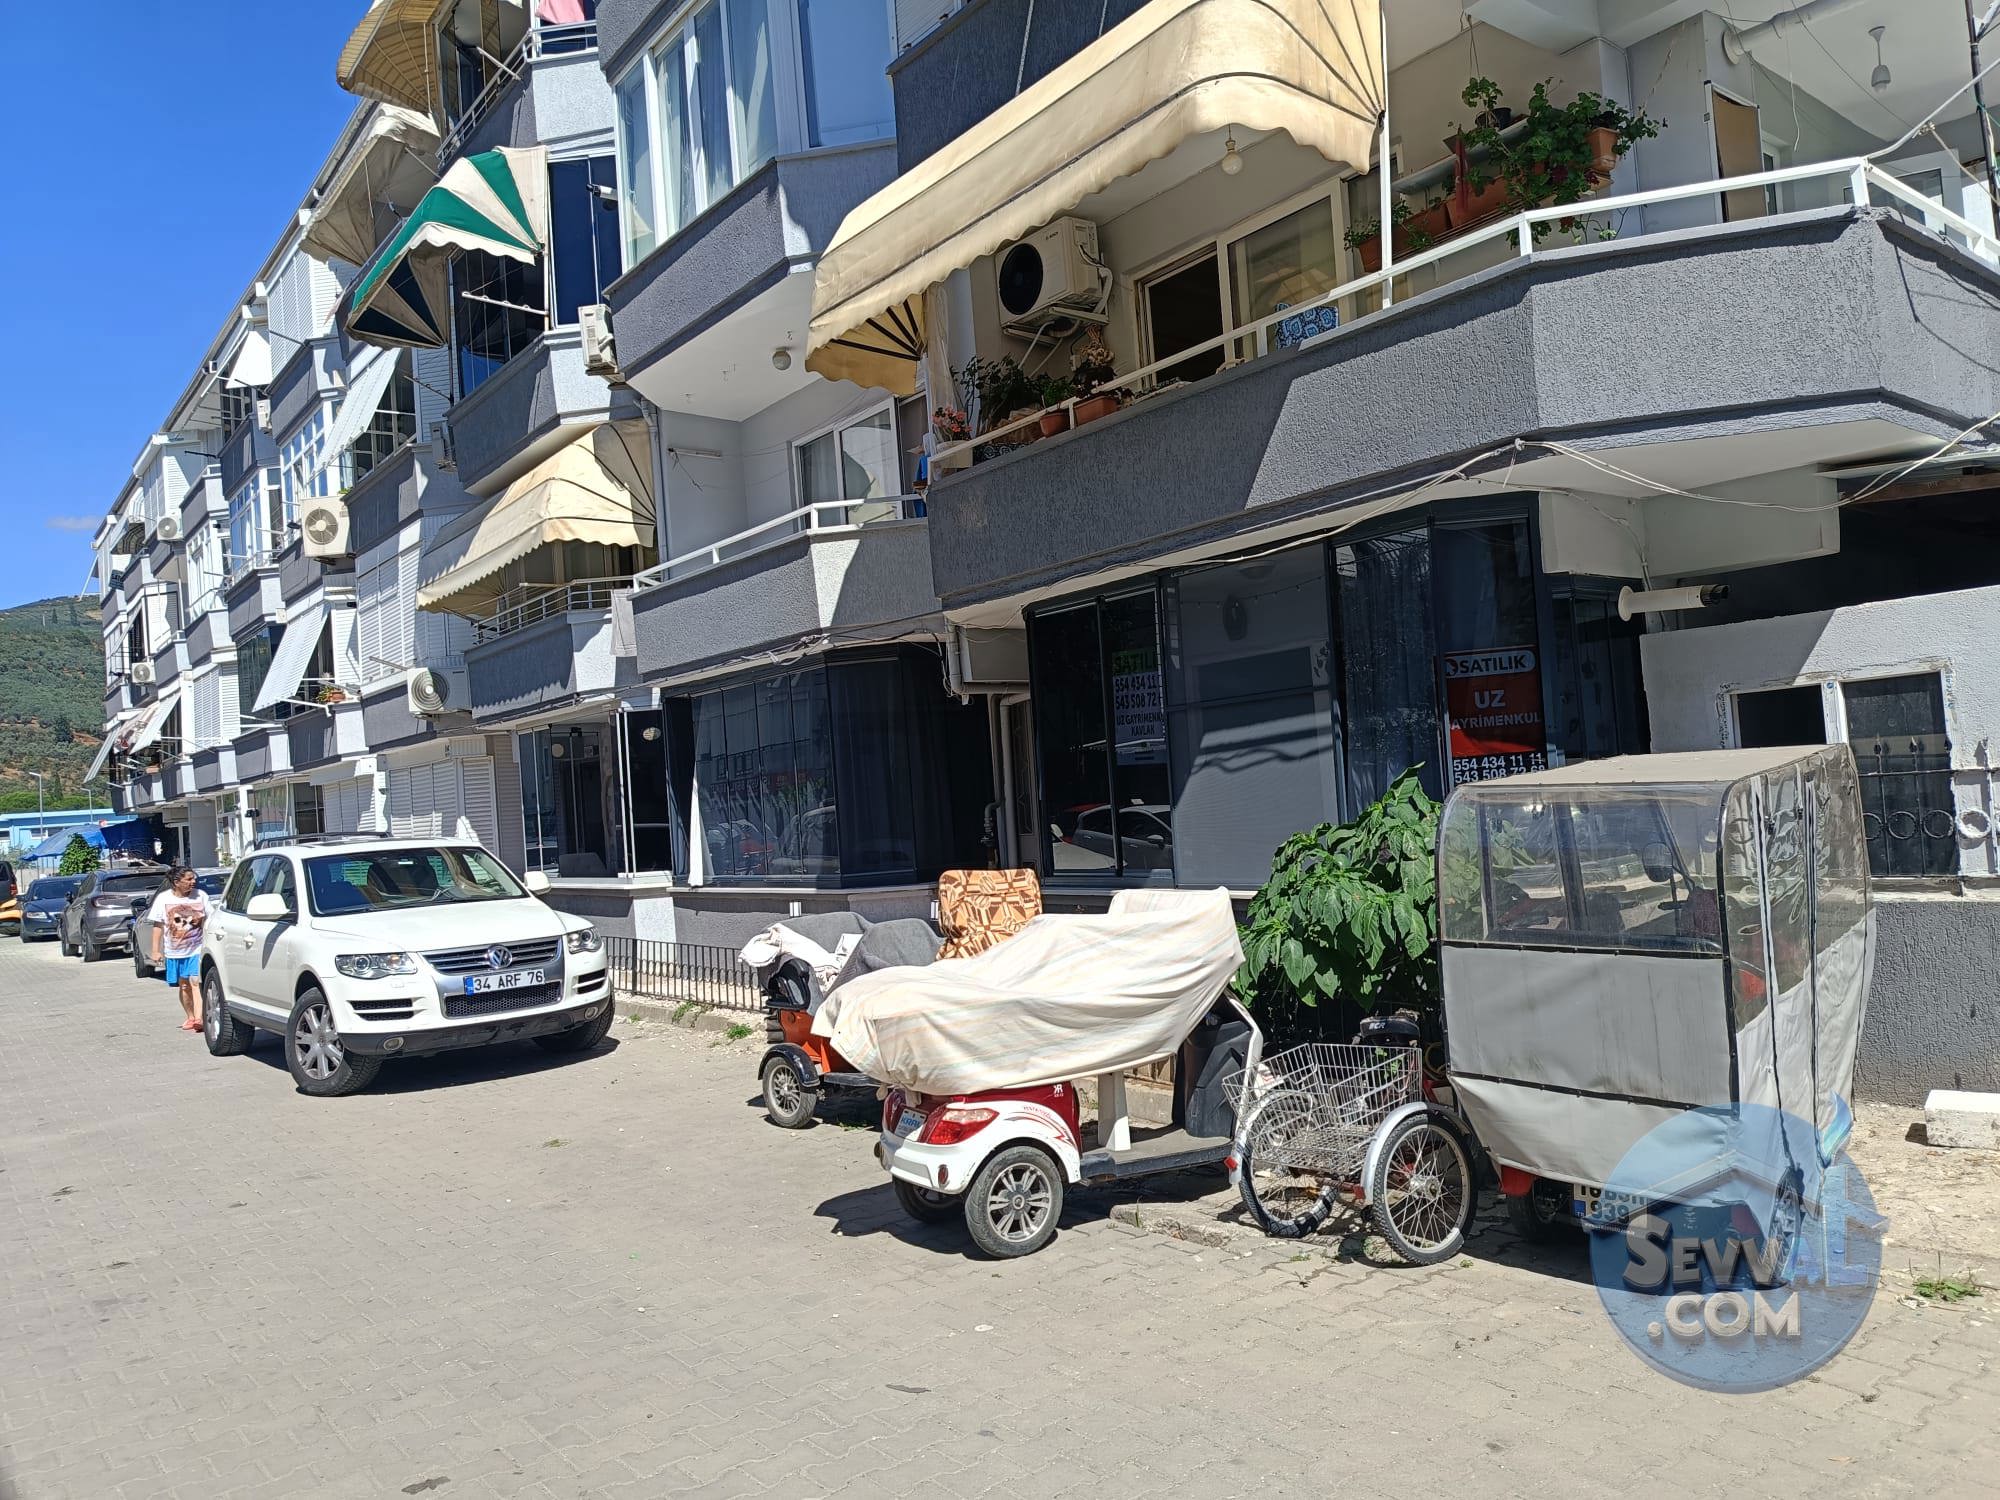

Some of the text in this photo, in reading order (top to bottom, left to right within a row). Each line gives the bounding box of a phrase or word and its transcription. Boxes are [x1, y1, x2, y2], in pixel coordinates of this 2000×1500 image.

[1460, 654, 1528, 674] SATILIK
[1474, 689, 1506, 709] UZ
[1451, 712, 1541, 730] AYRİMENKUL
[1453, 752, 1542, 771] 554 434 11 11
[1454, 770, 1479, 783] 543
[1482, 768, 1506, 781] 508
[474, 971, 543, 991] 34 ARF 76
